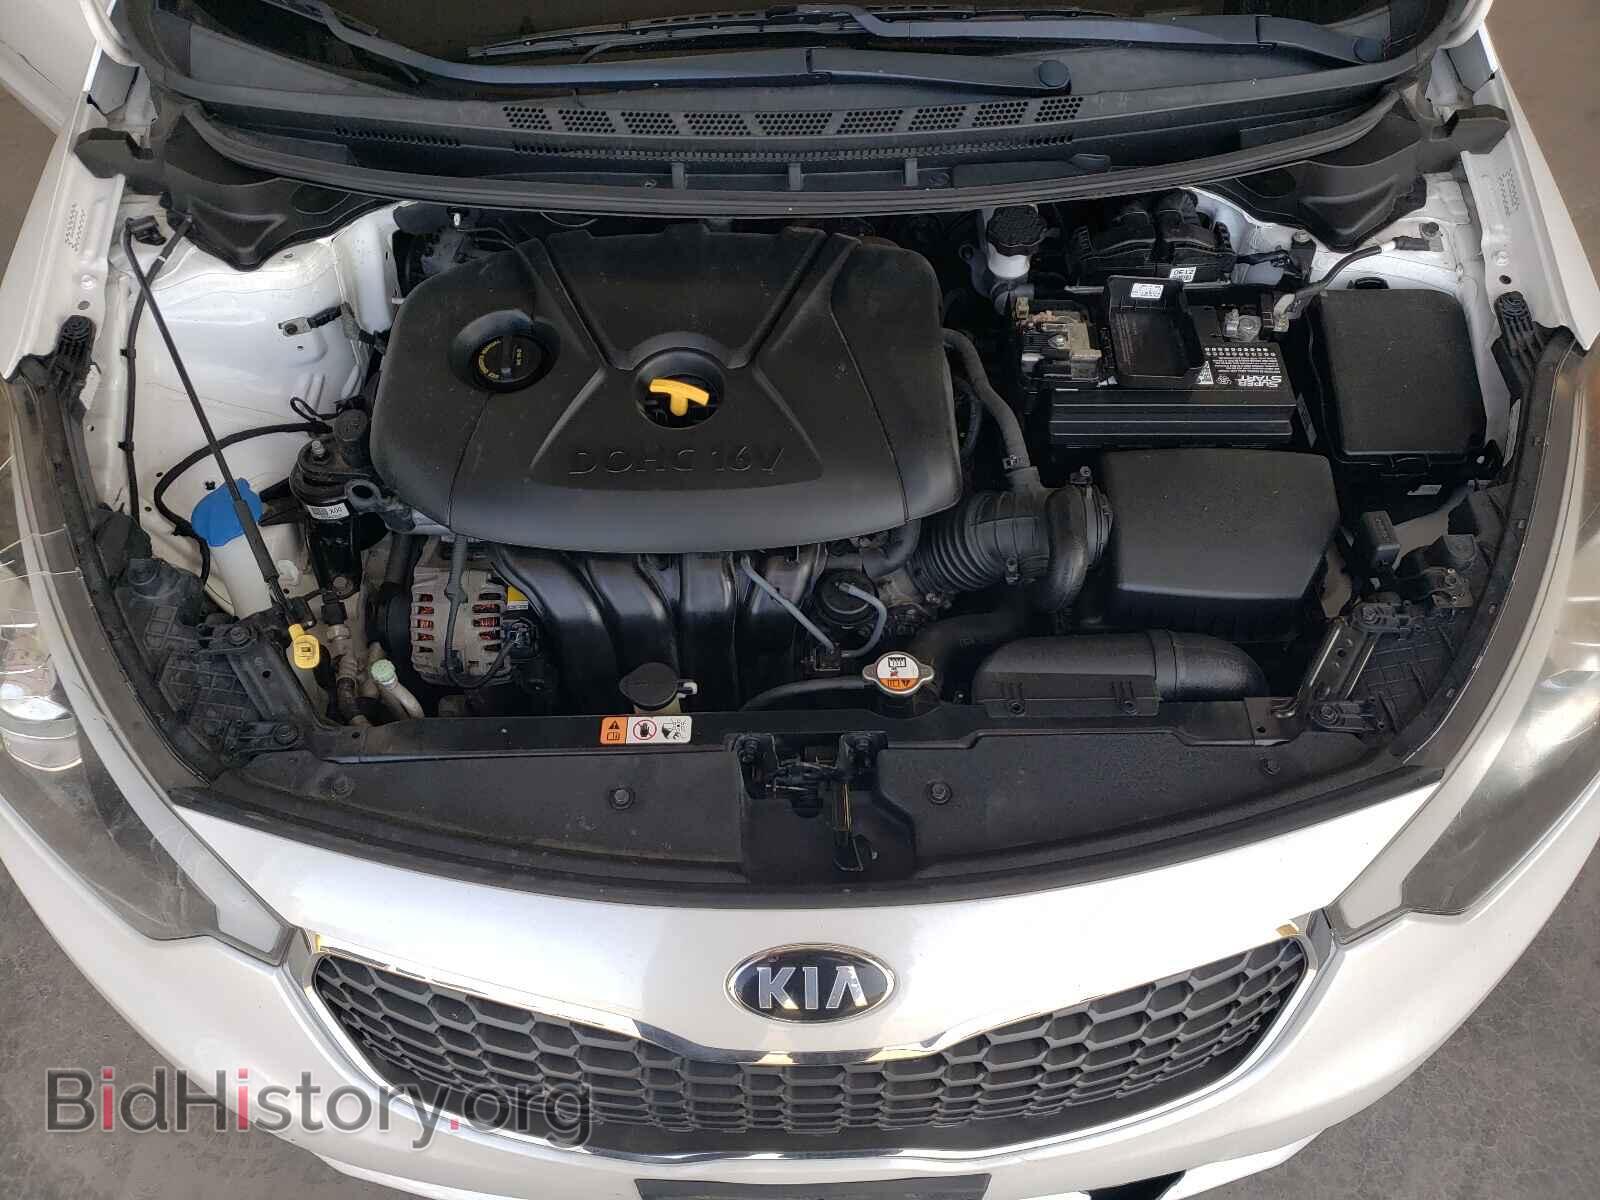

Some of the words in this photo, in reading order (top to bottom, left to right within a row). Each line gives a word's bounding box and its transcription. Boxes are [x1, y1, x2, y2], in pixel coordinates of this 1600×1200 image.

[568, 449, 698, 475] DOHC
[711, 446, 785, 474] 16V
[757, 965, 868, 1010] KIA
